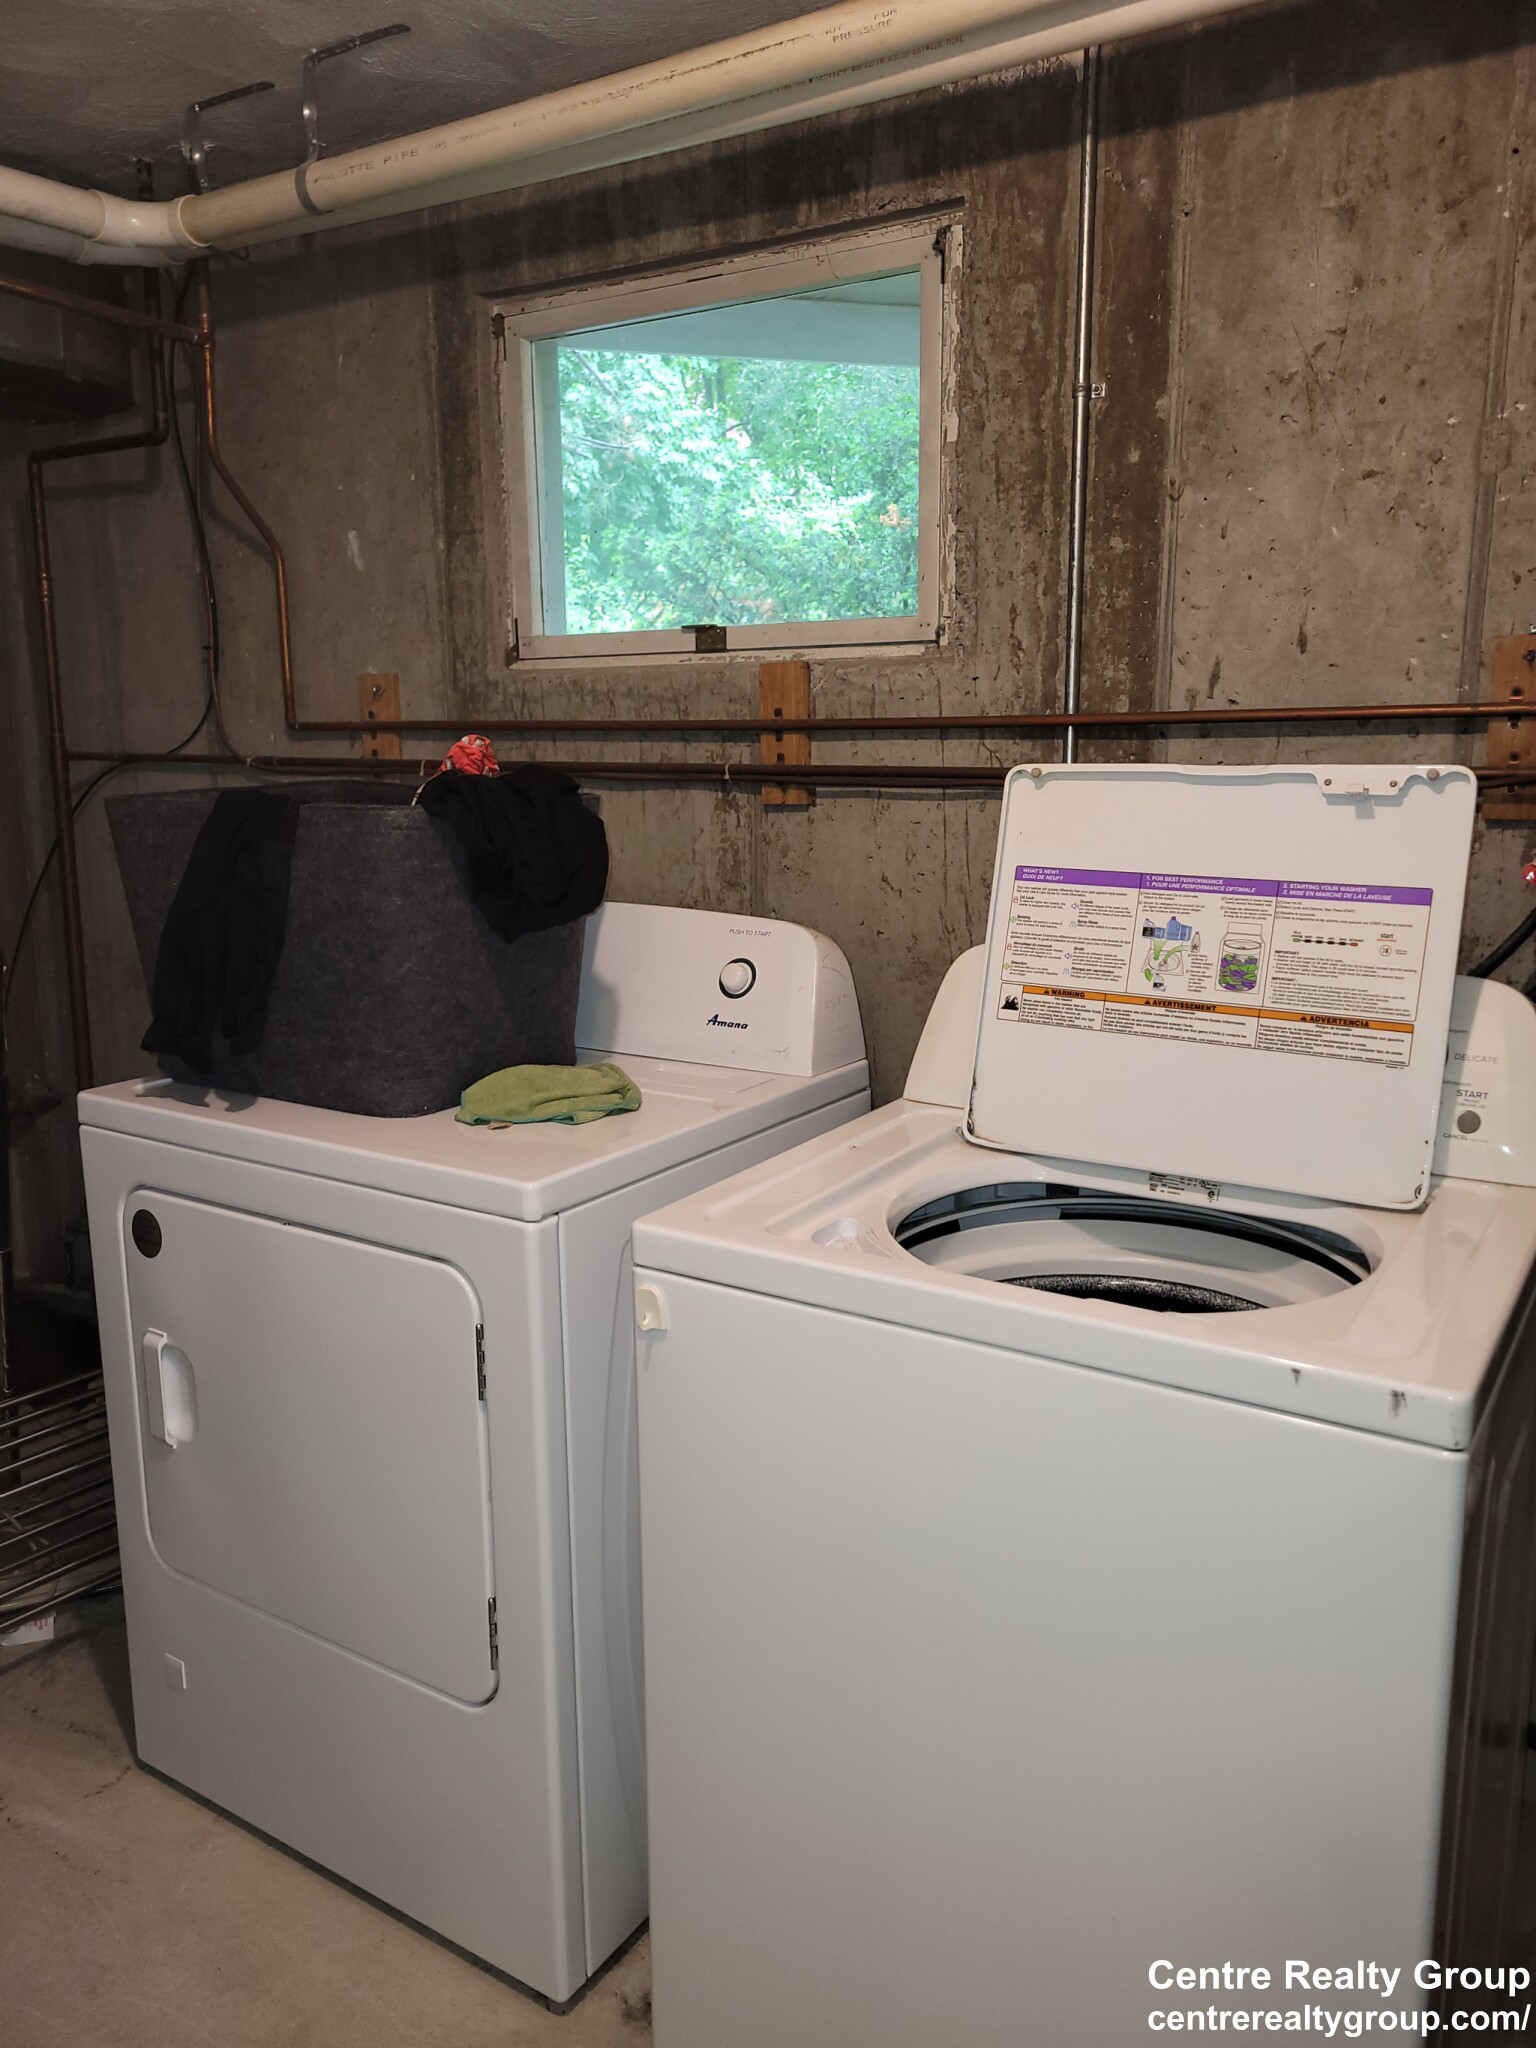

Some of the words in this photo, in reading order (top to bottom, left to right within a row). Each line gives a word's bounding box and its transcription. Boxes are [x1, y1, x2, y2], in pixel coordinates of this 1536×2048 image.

[832, 18, 896, 43] PRESSURE
[383, 148, 419, 165] PIPE
[1051, 988, 1085, 998] WARNING
[1152, 999, 1216, 1012] AVERTISSEMENT
[706, 1014, 748, 1029] Amana
[1309, 1015, 1370, 1028] ADVERTENCIA
[1454, 1053, 1498, 1064] DELICATE
[1456, 1089, 1489, 1099] START
[1443, 1132, 1468, 1141] CANCEL
